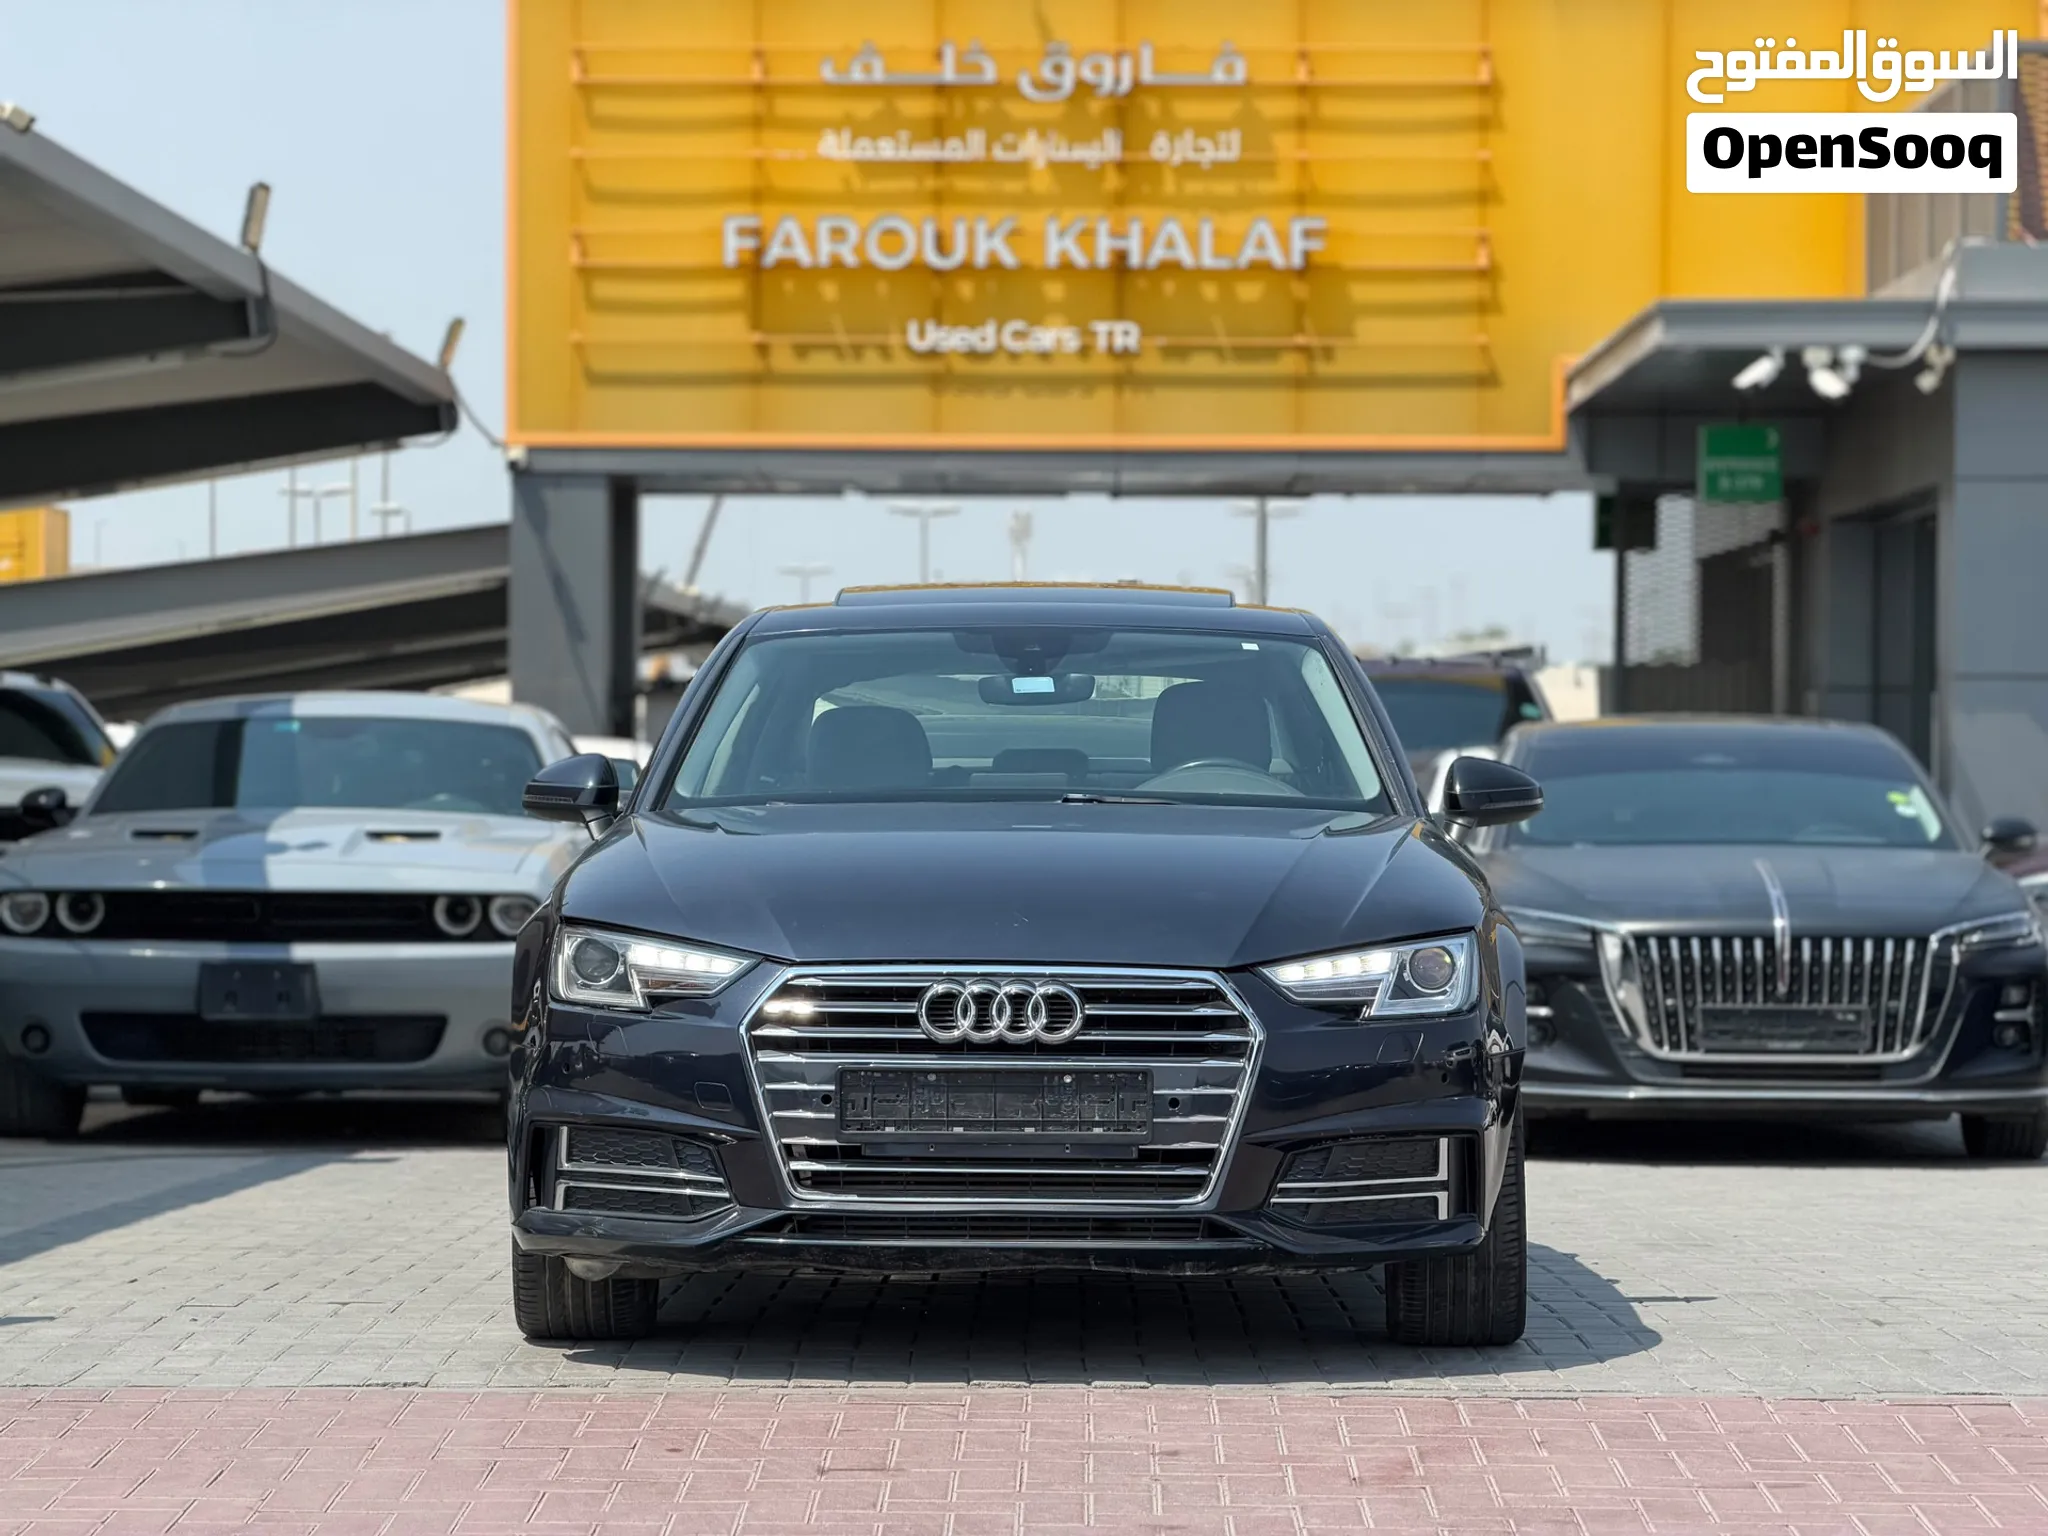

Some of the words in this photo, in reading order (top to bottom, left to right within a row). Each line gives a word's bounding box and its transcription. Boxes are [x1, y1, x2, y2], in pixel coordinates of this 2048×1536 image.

[819, 40, 998, 85] خلف
[1017, 41, 1248, 102] فاروق
[721, 216, 1019, 270] FAROUK
[1043, 216, 1329, 270] KHALAF
[906, 319, 998, 354] Used
[1001, 319, 1081, 354] Cars
[1091, 320, 1142, 354] TR
